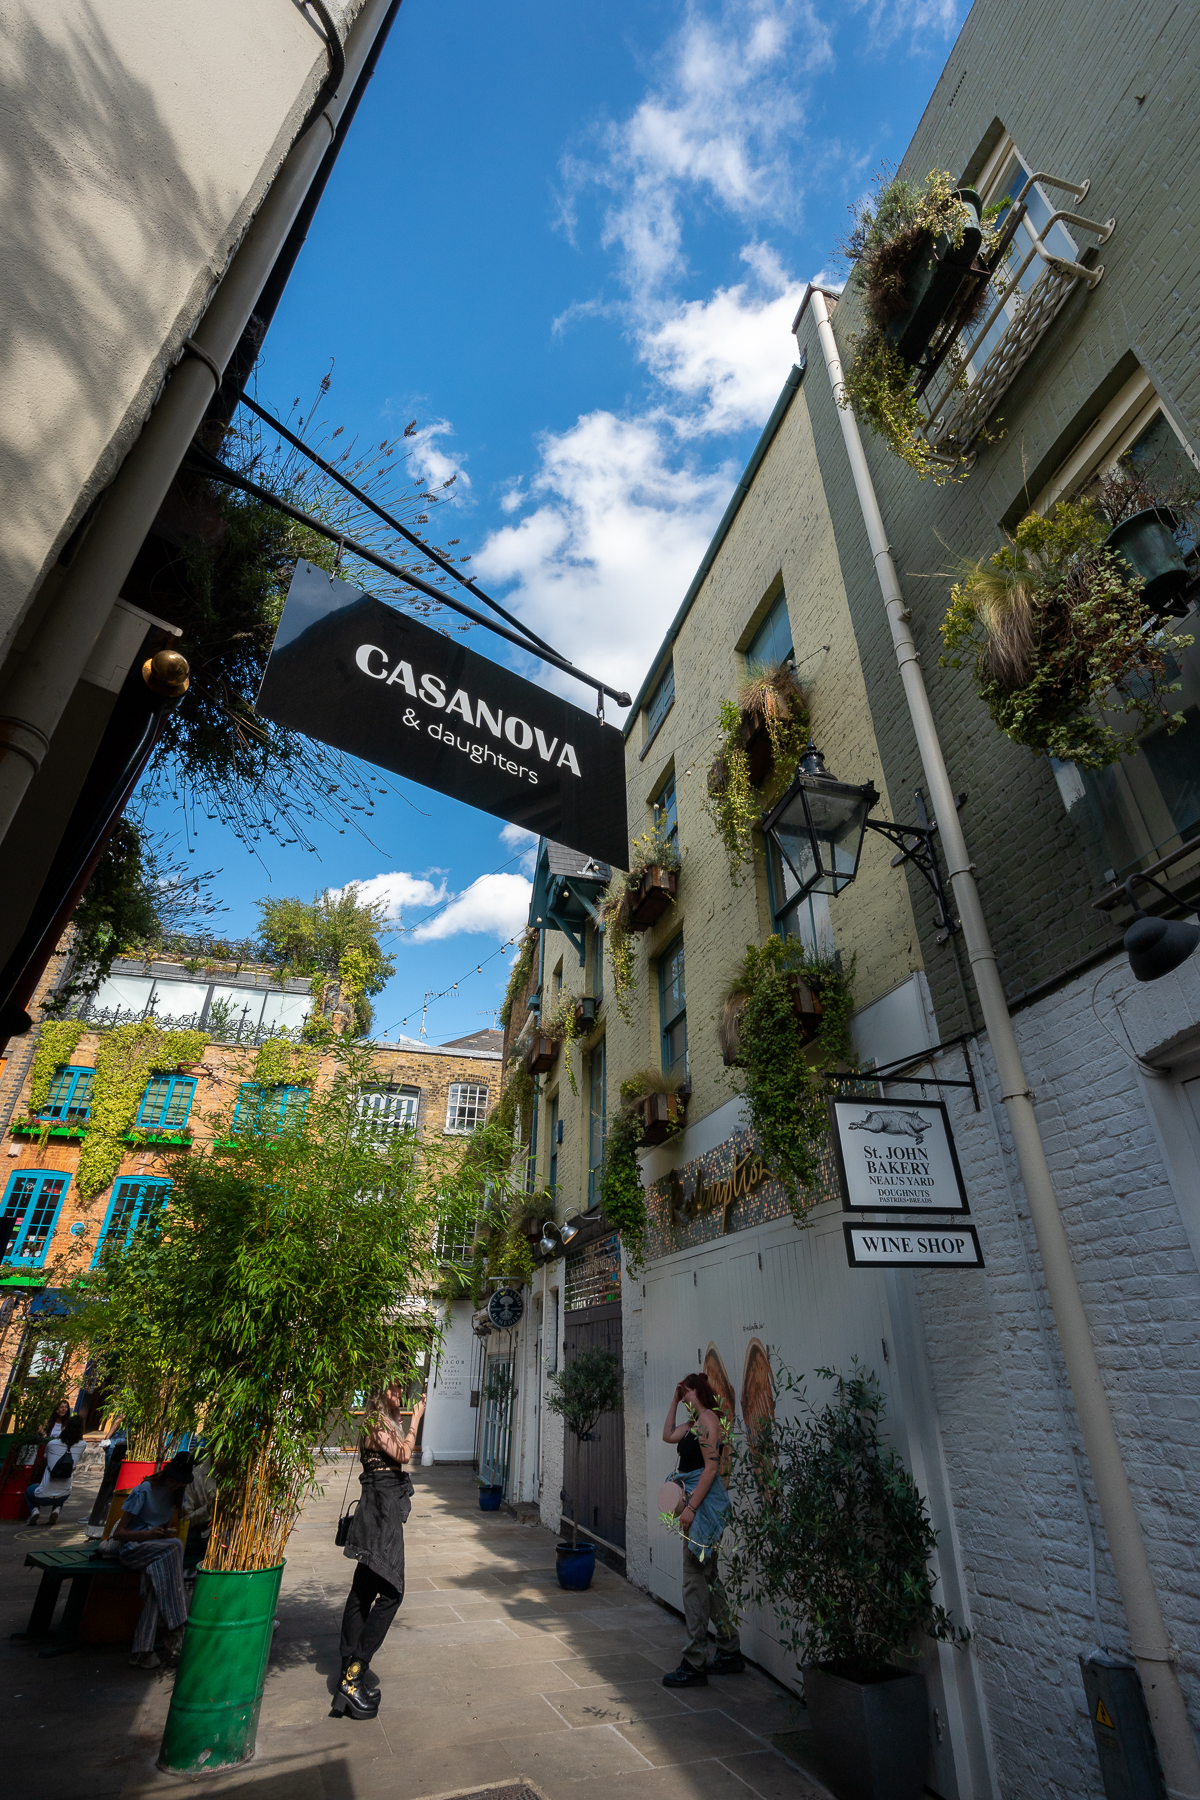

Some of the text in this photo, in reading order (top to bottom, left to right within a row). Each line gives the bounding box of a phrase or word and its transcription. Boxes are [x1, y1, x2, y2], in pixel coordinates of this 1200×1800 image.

[355, 644, 582, 777] CASANOVA
[402, 708, 539, 785] & daughters
[863, 1146, 928, 1160] St. JOHN
[867, 1161, 931, 1175] BAKERY
[869, 1176, 935, 1186] NEAL'S YARD
[878, 1189, 930, 1197] DOUGHNUTS
[861, 1236, 965, 1254] WINE SHOP
